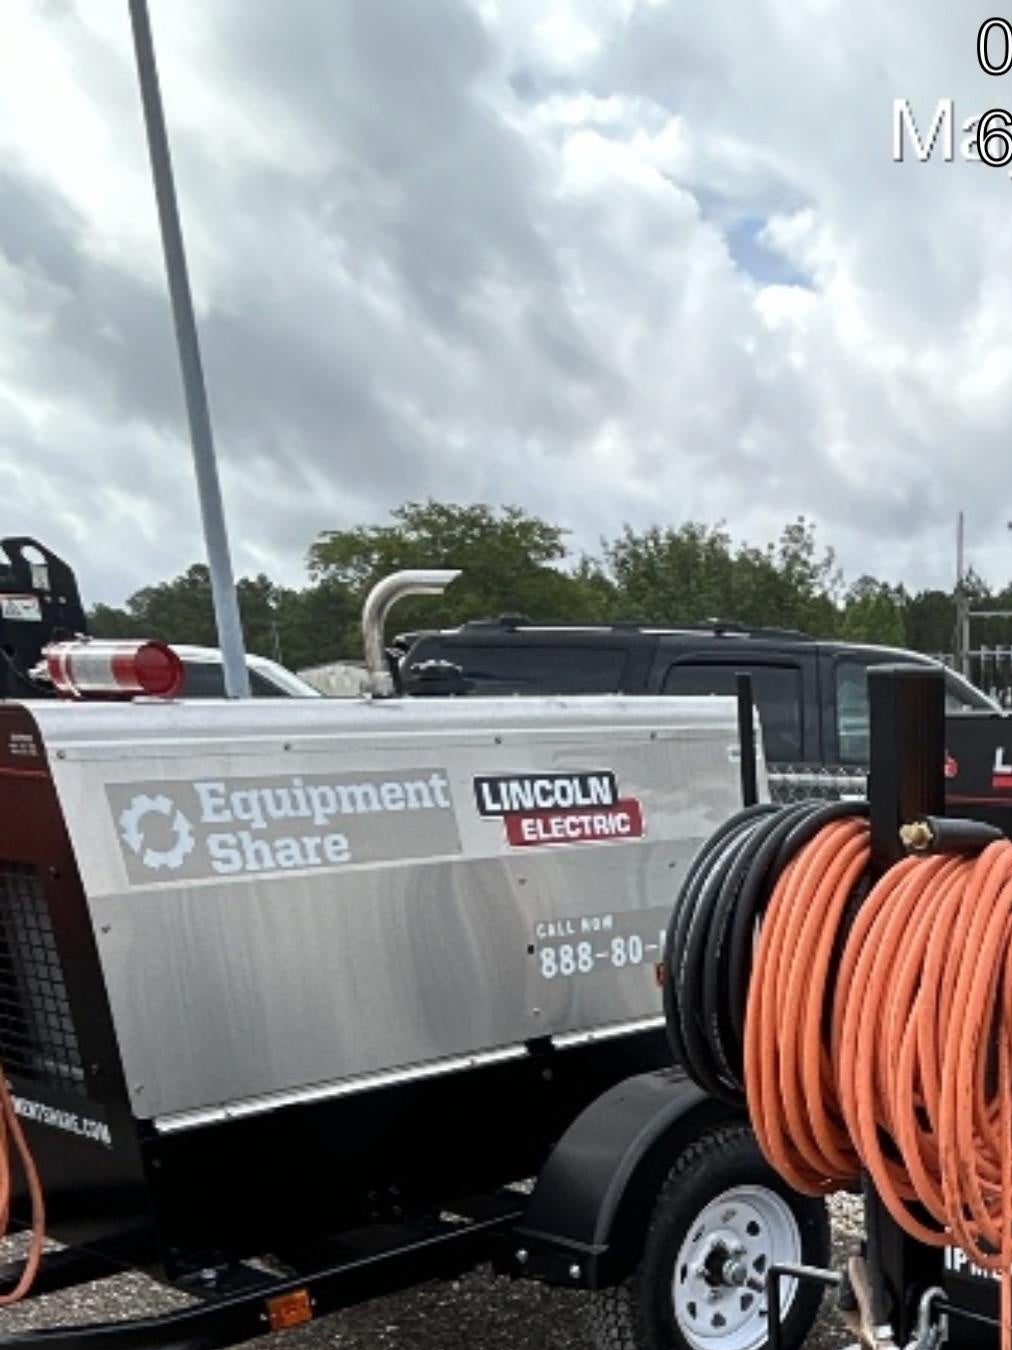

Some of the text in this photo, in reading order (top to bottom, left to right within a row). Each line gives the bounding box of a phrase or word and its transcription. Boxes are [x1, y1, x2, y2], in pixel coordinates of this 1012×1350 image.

[193, 771, 451, 829] Equipment
[481, 776, 613, 811] LINCOLN
[520, 812, 631, 841] ELECTRIC
[204, 831, 351, 874] Share
[536, 919, 576, 938] CALL
